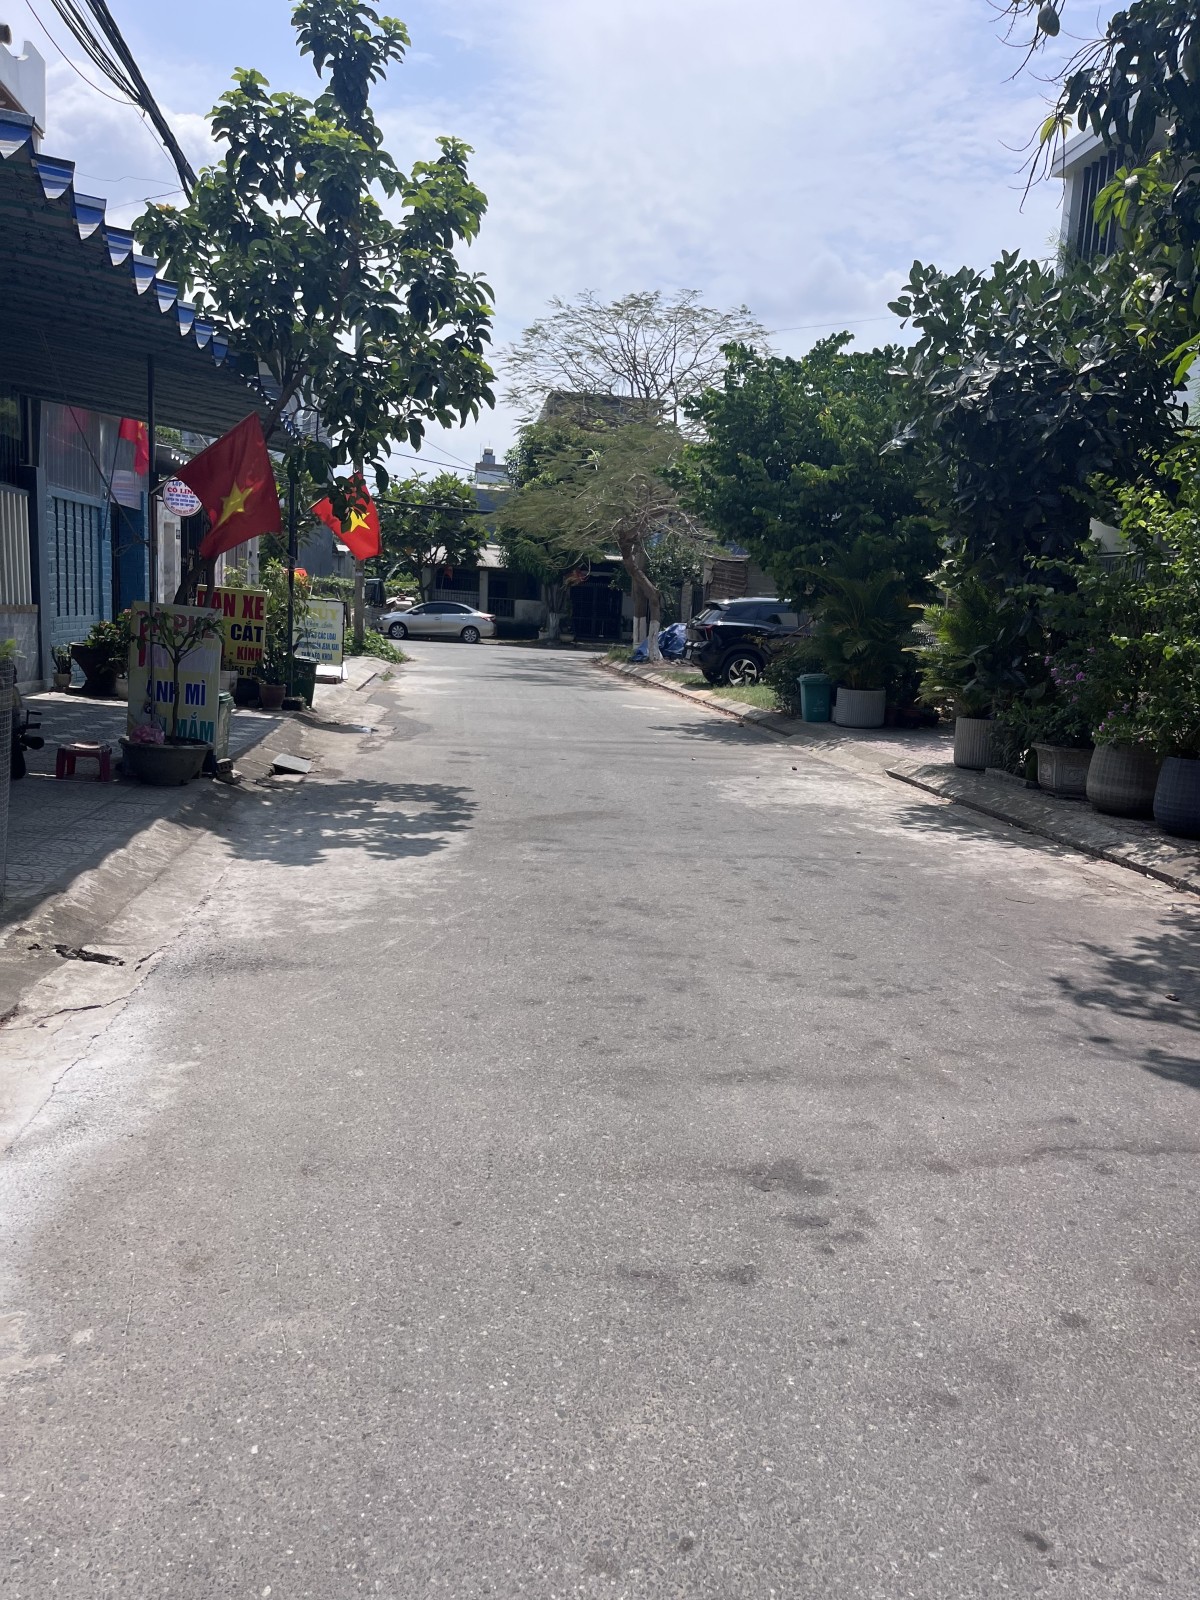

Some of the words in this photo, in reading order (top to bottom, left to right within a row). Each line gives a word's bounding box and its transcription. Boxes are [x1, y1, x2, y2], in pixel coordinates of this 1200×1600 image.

[242, 594, 265, 620] XE
[231, 621, 263, 642] CẮT
[237, 644, 263, 661] KÍNH
[185, 680, 206, 706] MÌ
[176, 711, 214, 742] MẮM
